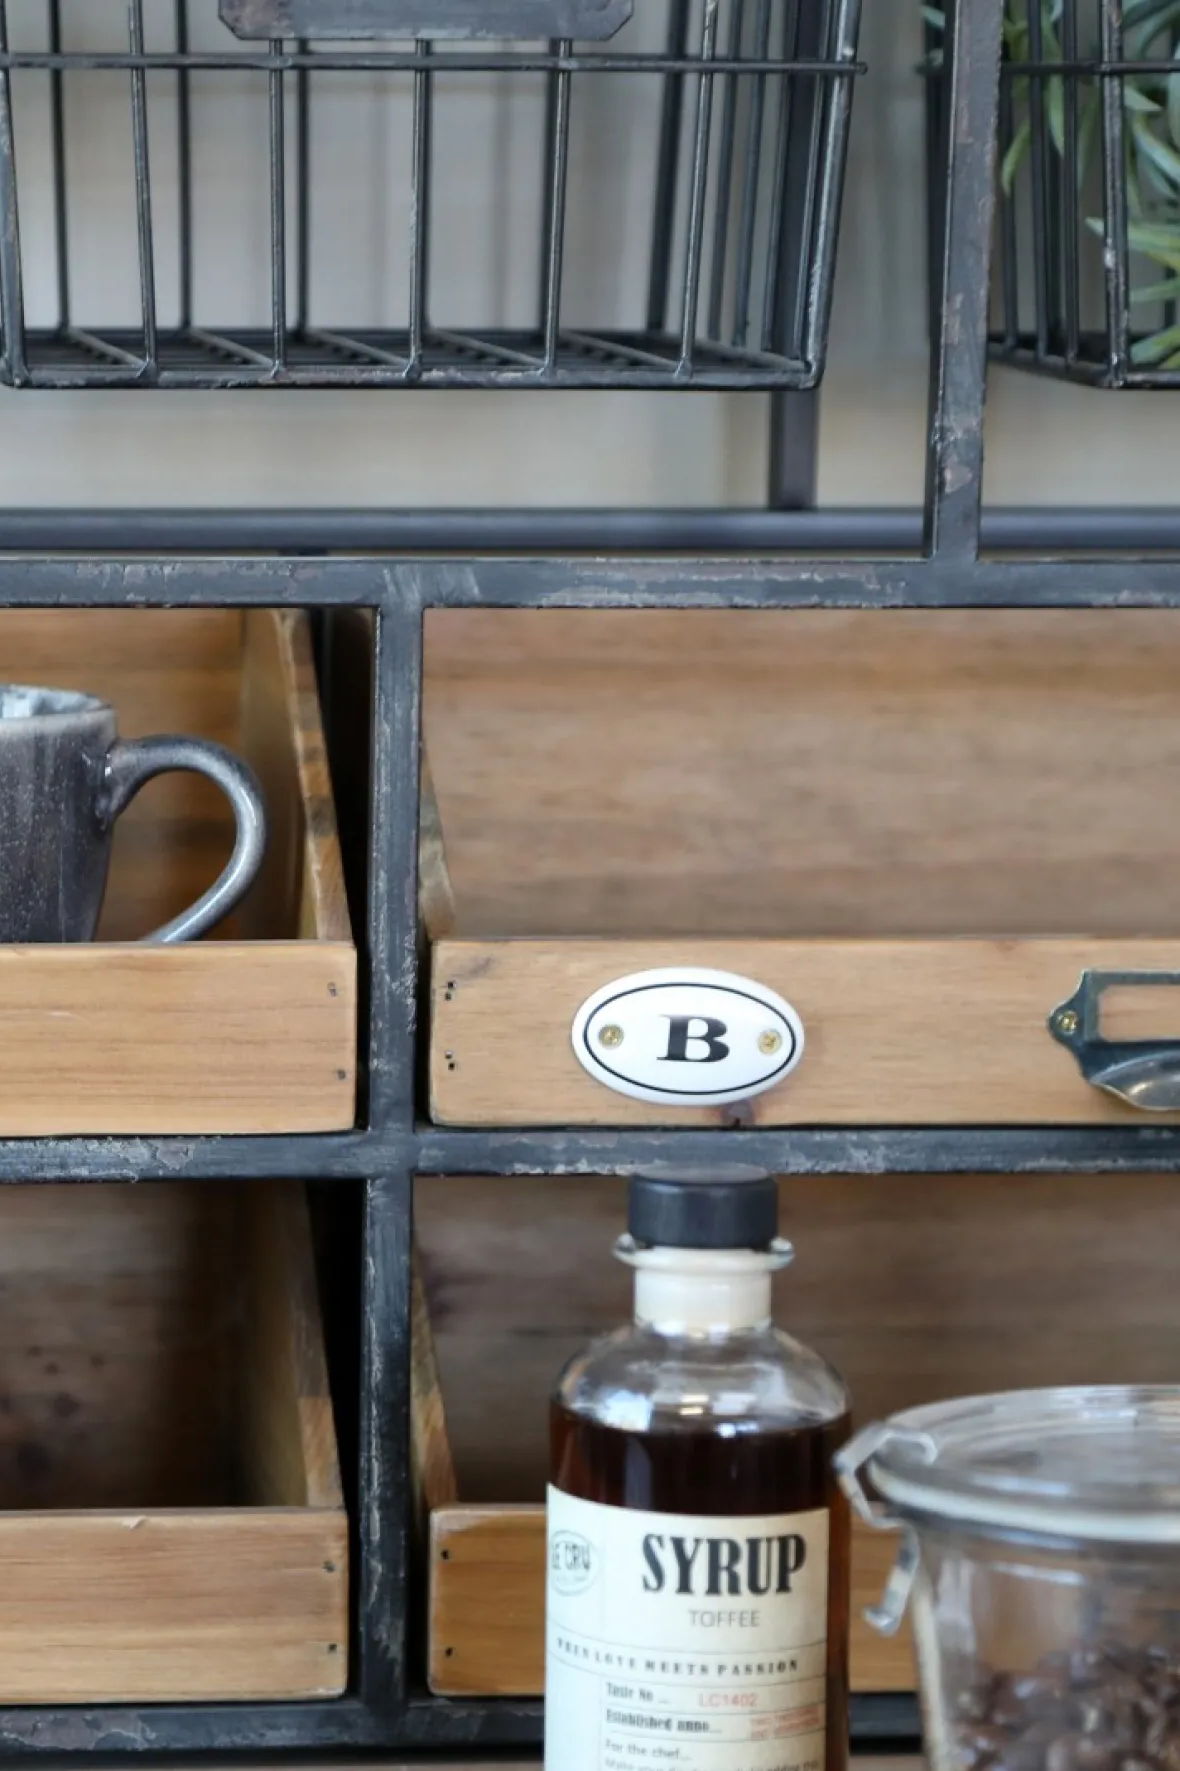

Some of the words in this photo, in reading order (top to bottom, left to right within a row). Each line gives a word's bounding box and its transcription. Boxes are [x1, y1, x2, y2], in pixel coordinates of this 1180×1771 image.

[656, 1013, 730, 1063] B
[641, 1532, 807, 1597] SYRUP
[688, 1609, 761, 1628] TOFFEE
[594, 1650, 637, 1671] LOVE
[645, 1659, 710, 1677] MEETS
[718, 1658, 799, 1677] PASSION
[698, 1692, 758, 1708] LC1402
[606, 1708, 673, 1731] Established
